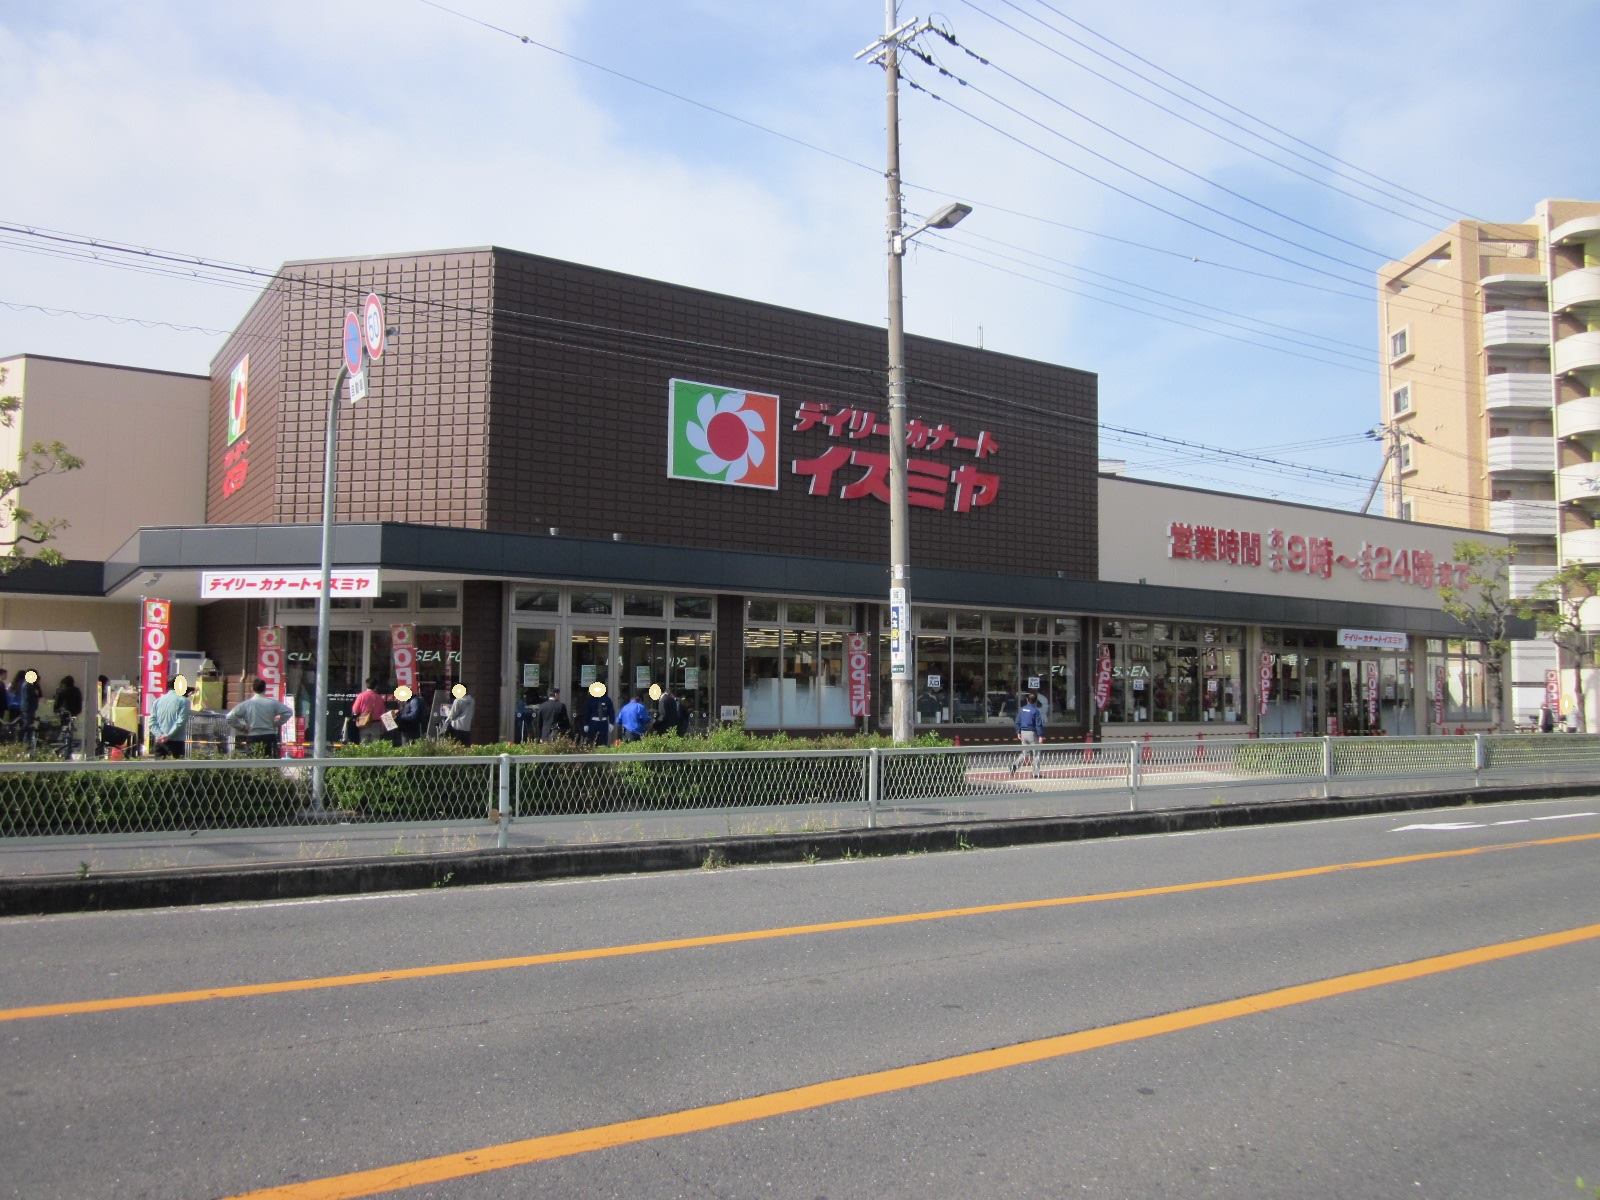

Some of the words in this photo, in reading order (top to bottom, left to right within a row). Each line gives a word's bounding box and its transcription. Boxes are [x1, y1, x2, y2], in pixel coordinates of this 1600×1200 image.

[368, 311, 379, 342] 50
[793, 402, 999, 459] デイリーカナート
[1167, 521, 1262, 567] 営業時間
